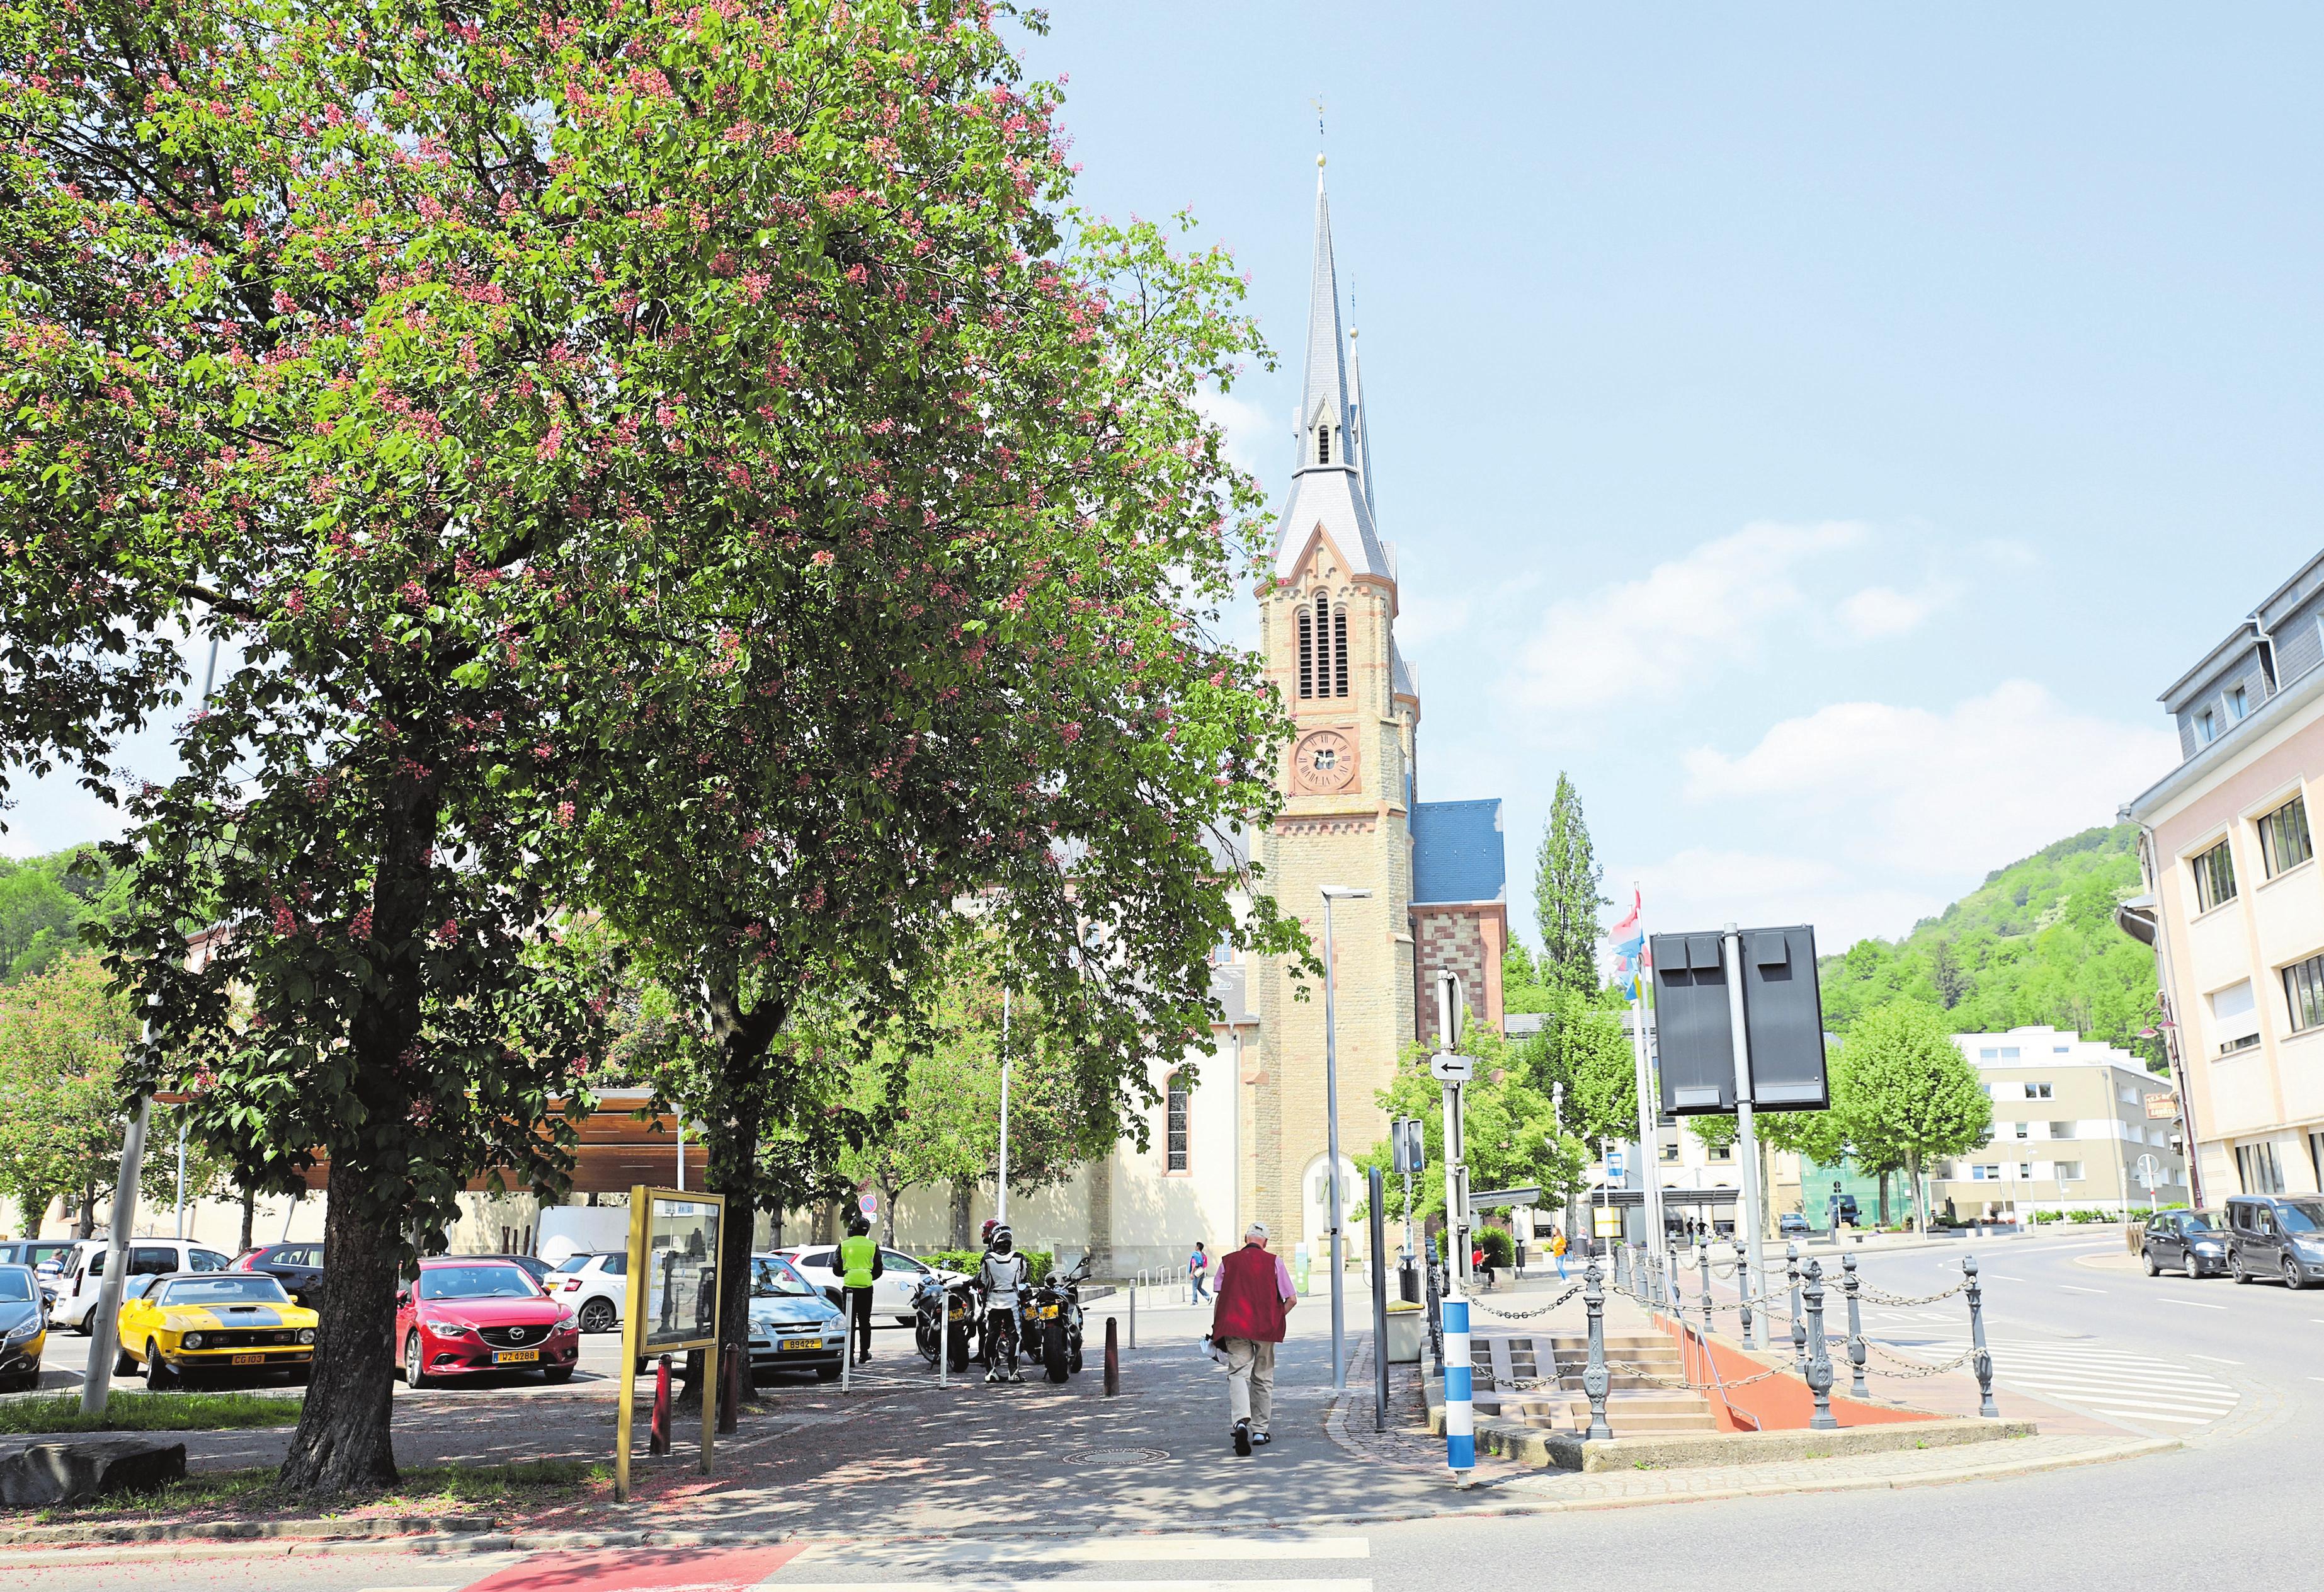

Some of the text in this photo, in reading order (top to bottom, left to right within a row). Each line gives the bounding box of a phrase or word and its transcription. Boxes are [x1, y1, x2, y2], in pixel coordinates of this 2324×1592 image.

[790, 1340, 814, 1348] 89422
[235, 1355, 262, 1364] CG 103
[503, 1351, 535, 1361] WZ 4288
